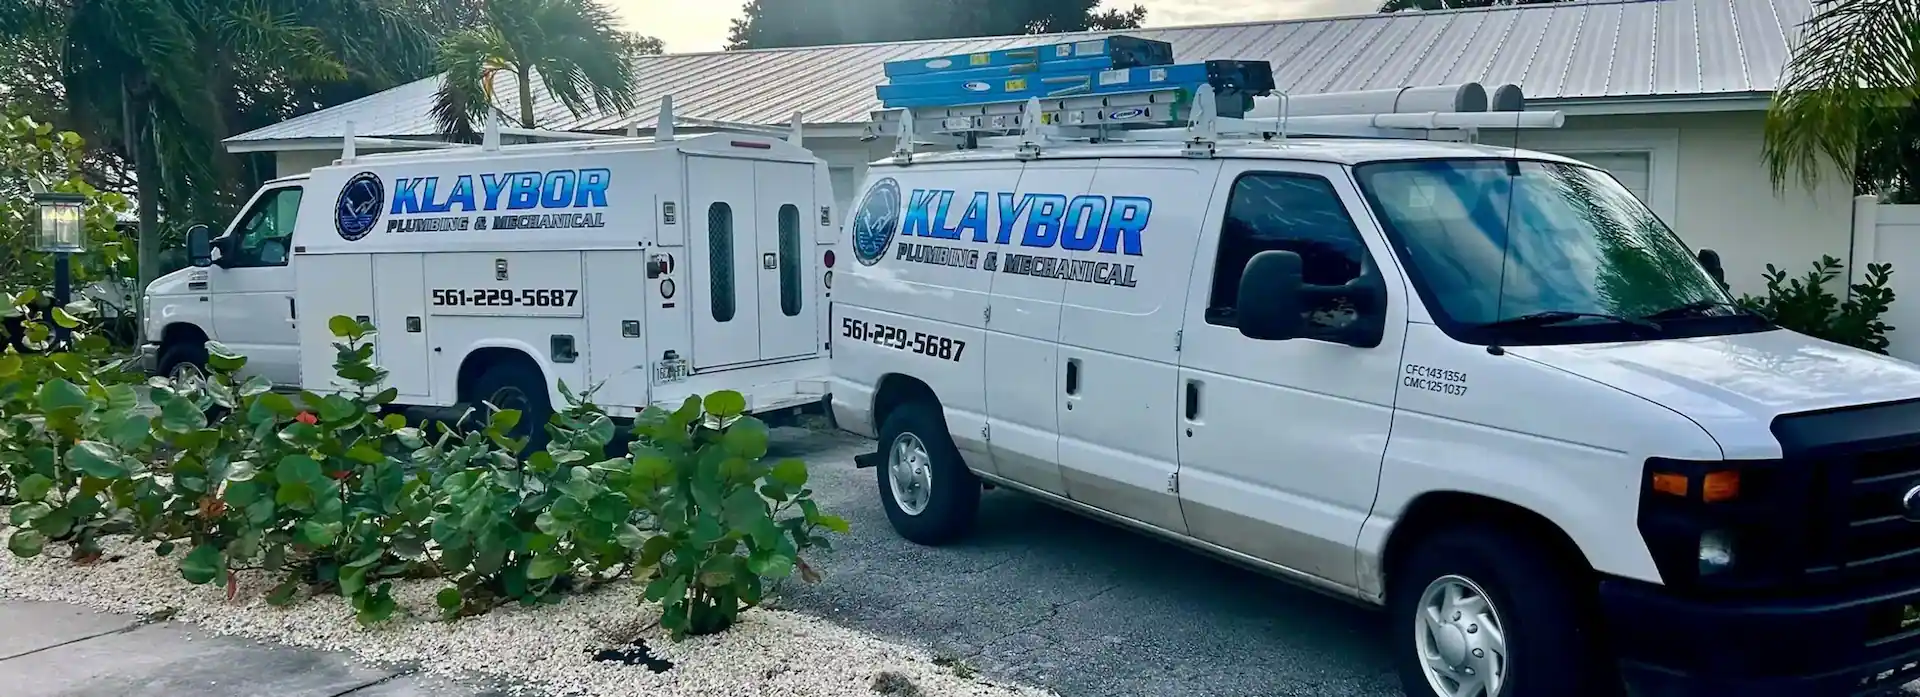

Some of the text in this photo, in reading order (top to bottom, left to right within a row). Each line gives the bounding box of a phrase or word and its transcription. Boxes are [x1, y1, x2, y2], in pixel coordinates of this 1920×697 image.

[390, 168, 611, 214] KLAYBOR
[386, 212, 605, 233] PLUMBING & MECHANICAL
[901, 189, 1152, 256] KLAYBOR
[896, 242, 1138, 288] PLUMBING & MECHANICAL
[432, 288, 579, 307] 561-229-5687
[843, 318, 966, 362] 561-229-5687
[1404, 376, 1467, 396] CMC1251037
[1406, 364, 1467, 382] CFC1431354
